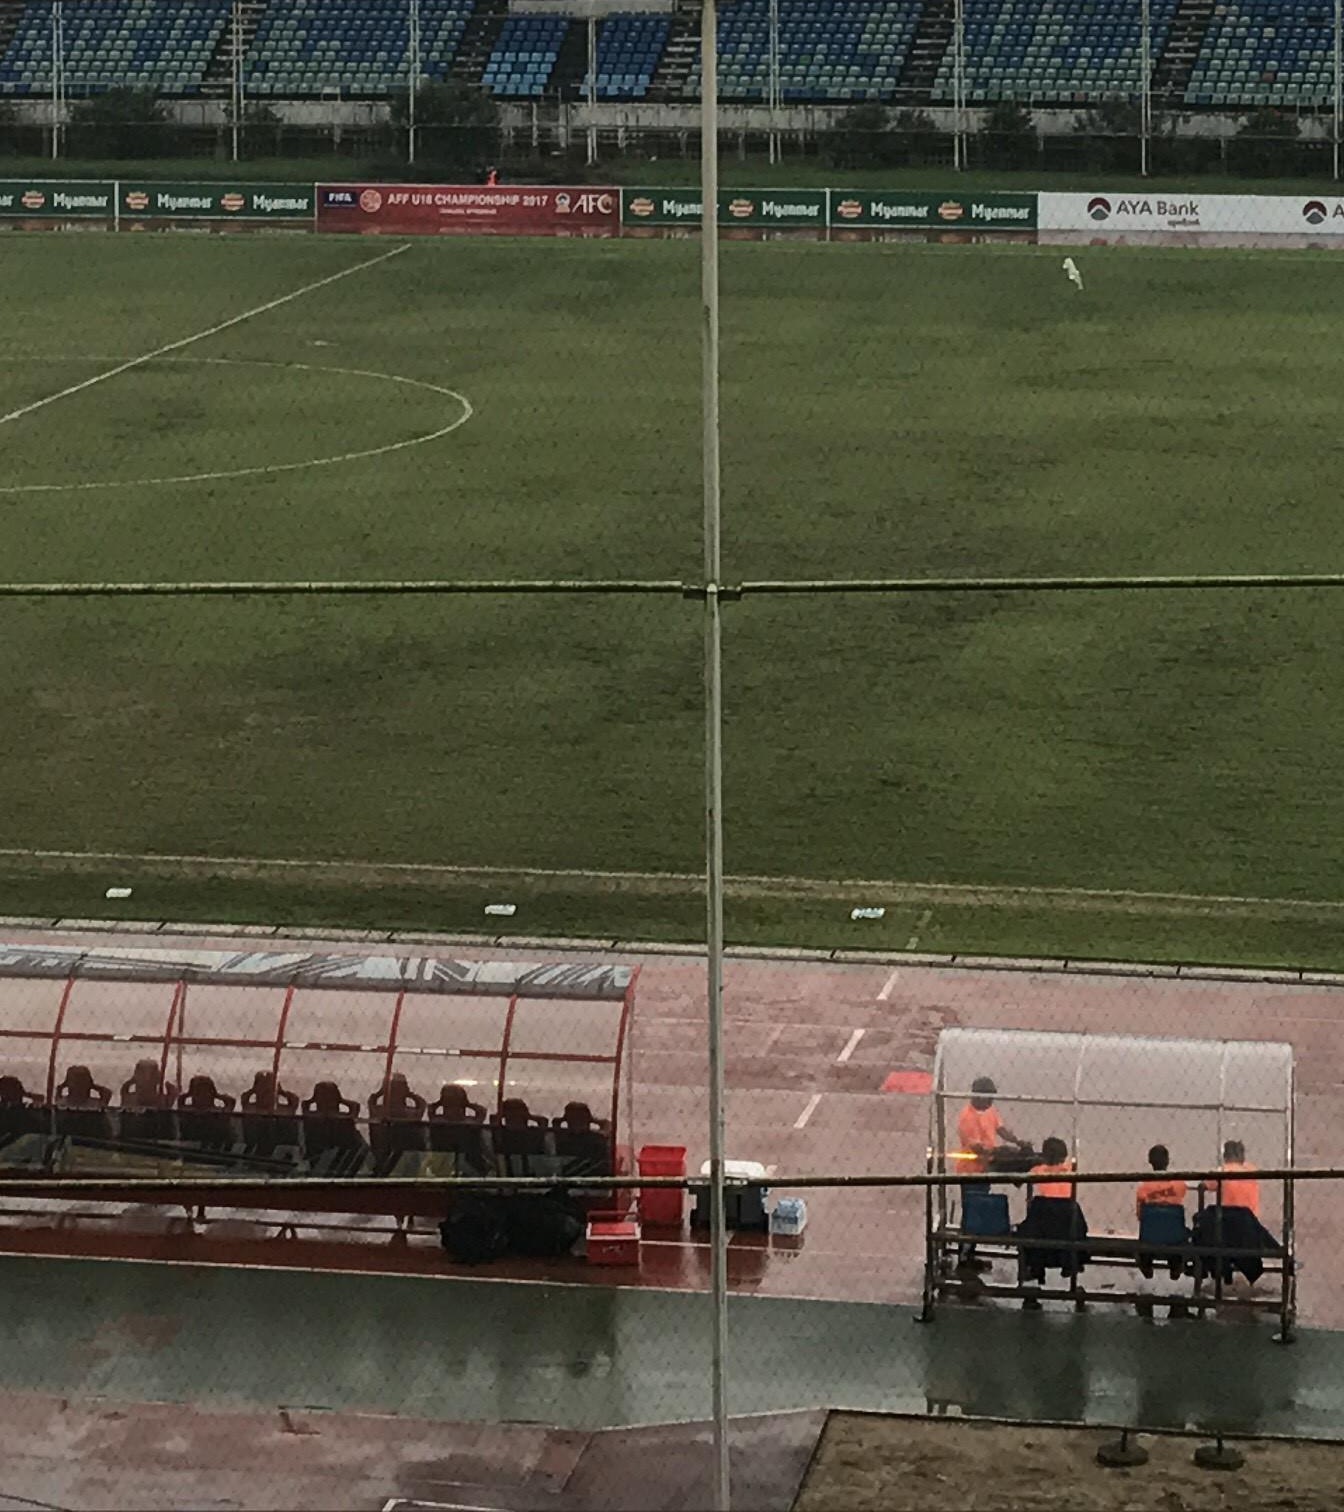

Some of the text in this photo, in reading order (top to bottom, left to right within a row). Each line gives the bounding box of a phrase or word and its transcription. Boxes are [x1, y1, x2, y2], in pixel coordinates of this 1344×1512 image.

[387, 192, 409, 205] AFF
[434, 194, 520, 206] CHAMPIONSHIP
[522, 195, 549, 207] 2017
[572, 193, 613, 214] AFC
[1117, 200, 1199, 216] AYA Bank
